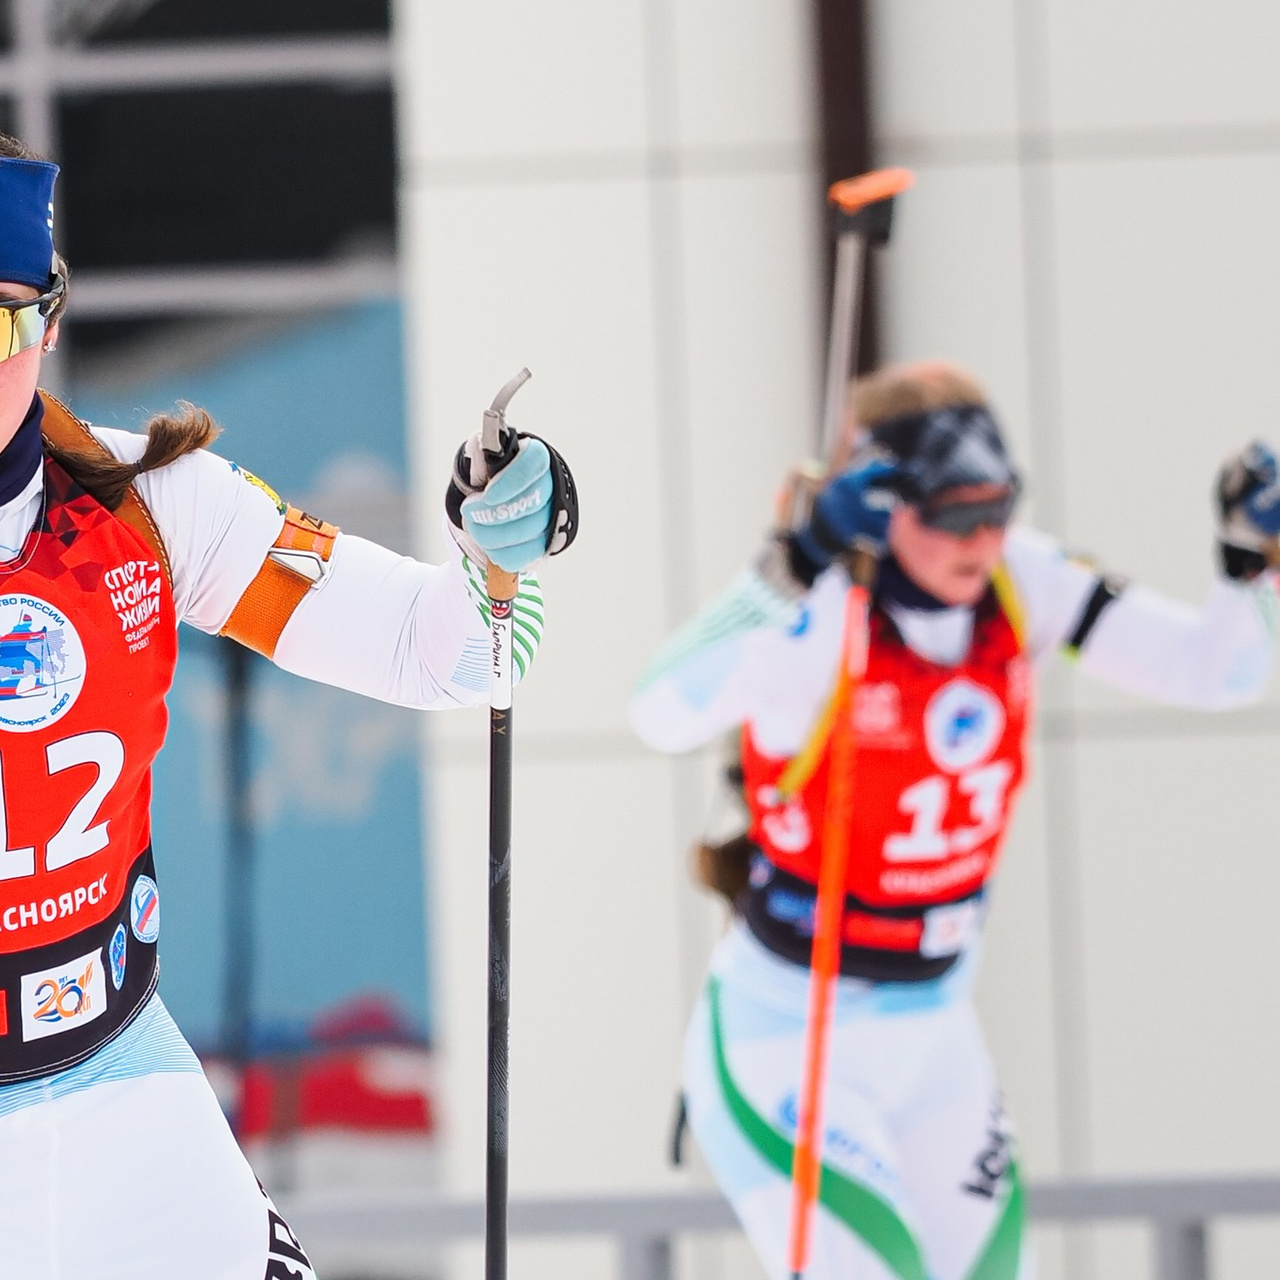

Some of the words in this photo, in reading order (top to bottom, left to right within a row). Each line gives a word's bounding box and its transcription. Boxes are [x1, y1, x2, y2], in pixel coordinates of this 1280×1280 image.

[20, 597, 66, 627] РОССИИ
[50, 692, 71, 716] 2023
[880, 757, 1015, 864] 13
[34, 978, 83, 1019] 20
